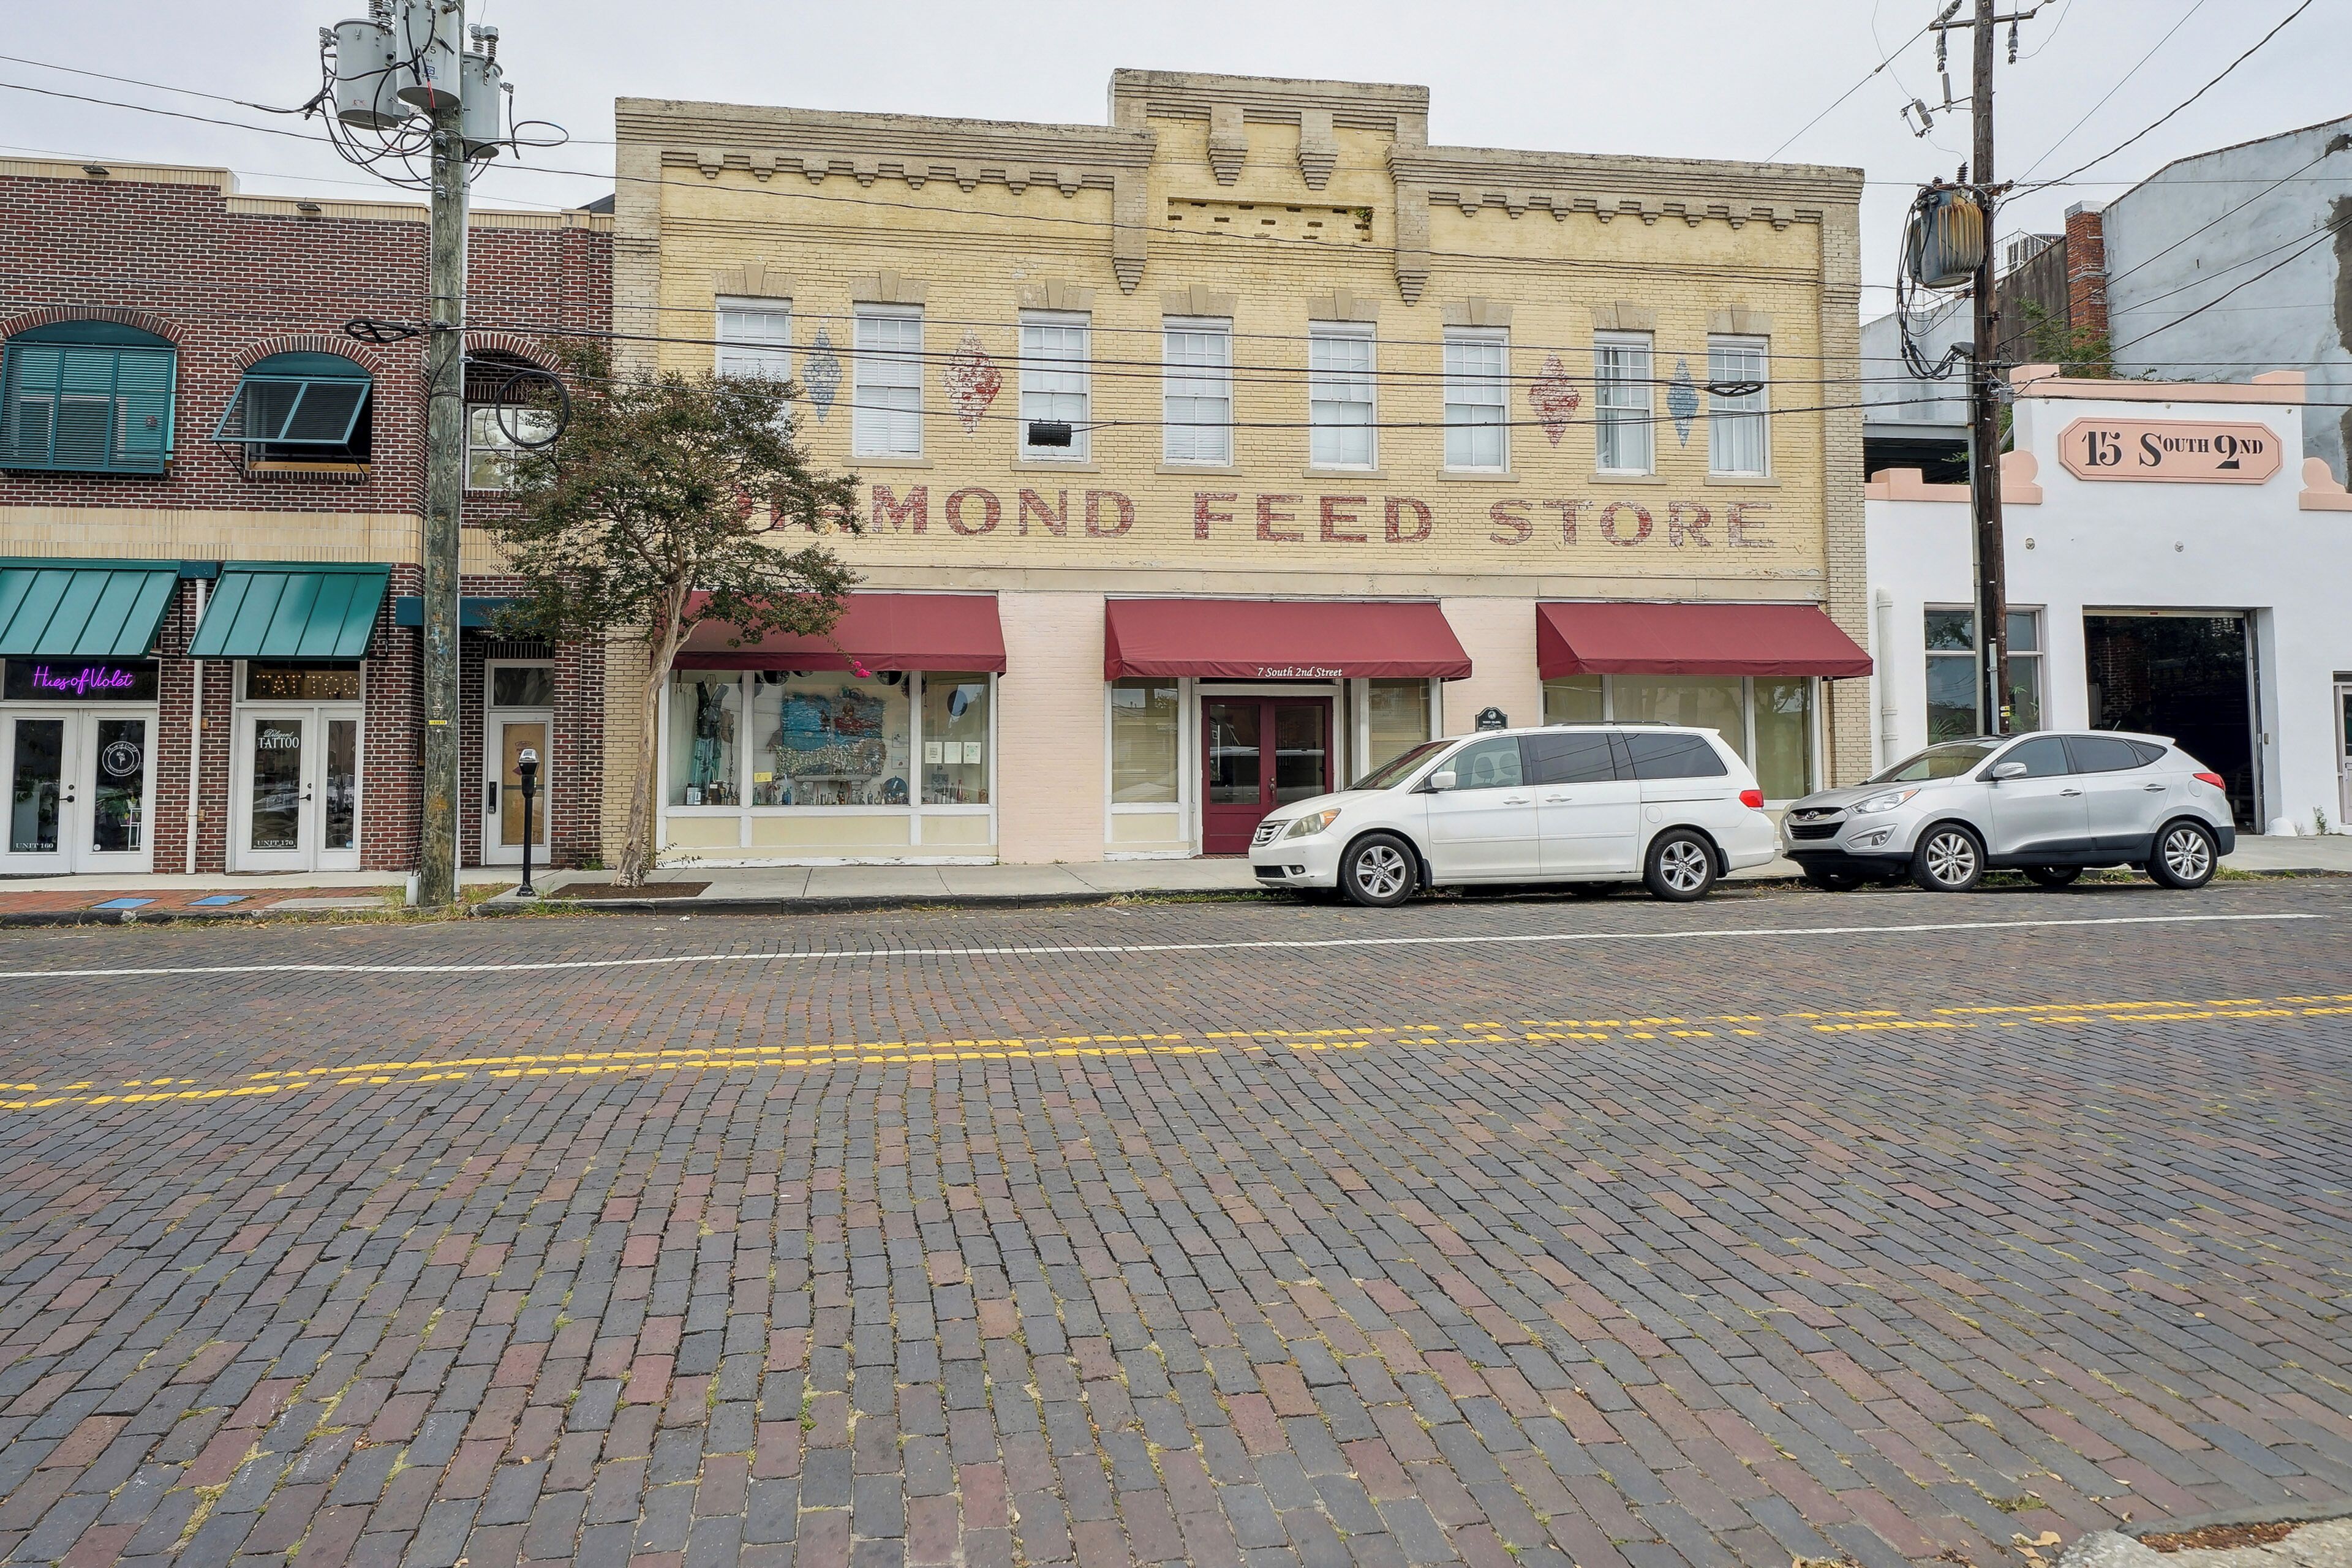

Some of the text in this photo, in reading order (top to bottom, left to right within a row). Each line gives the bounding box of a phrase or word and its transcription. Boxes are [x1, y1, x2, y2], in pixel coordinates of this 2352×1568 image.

[2081, 431, 2122, 466] 15
[2214, 434, 2264, 470] 2ND
[702, 483, 1775, 548] IMOND FEED STORE
[34, 666, 133, 695] Hues of Violet
[1257, 666, 1343, 677] 7 South 2nd Street
[256, 675, 360, 695] TATTOO
[258, 737, 300, 748] TATTOO
